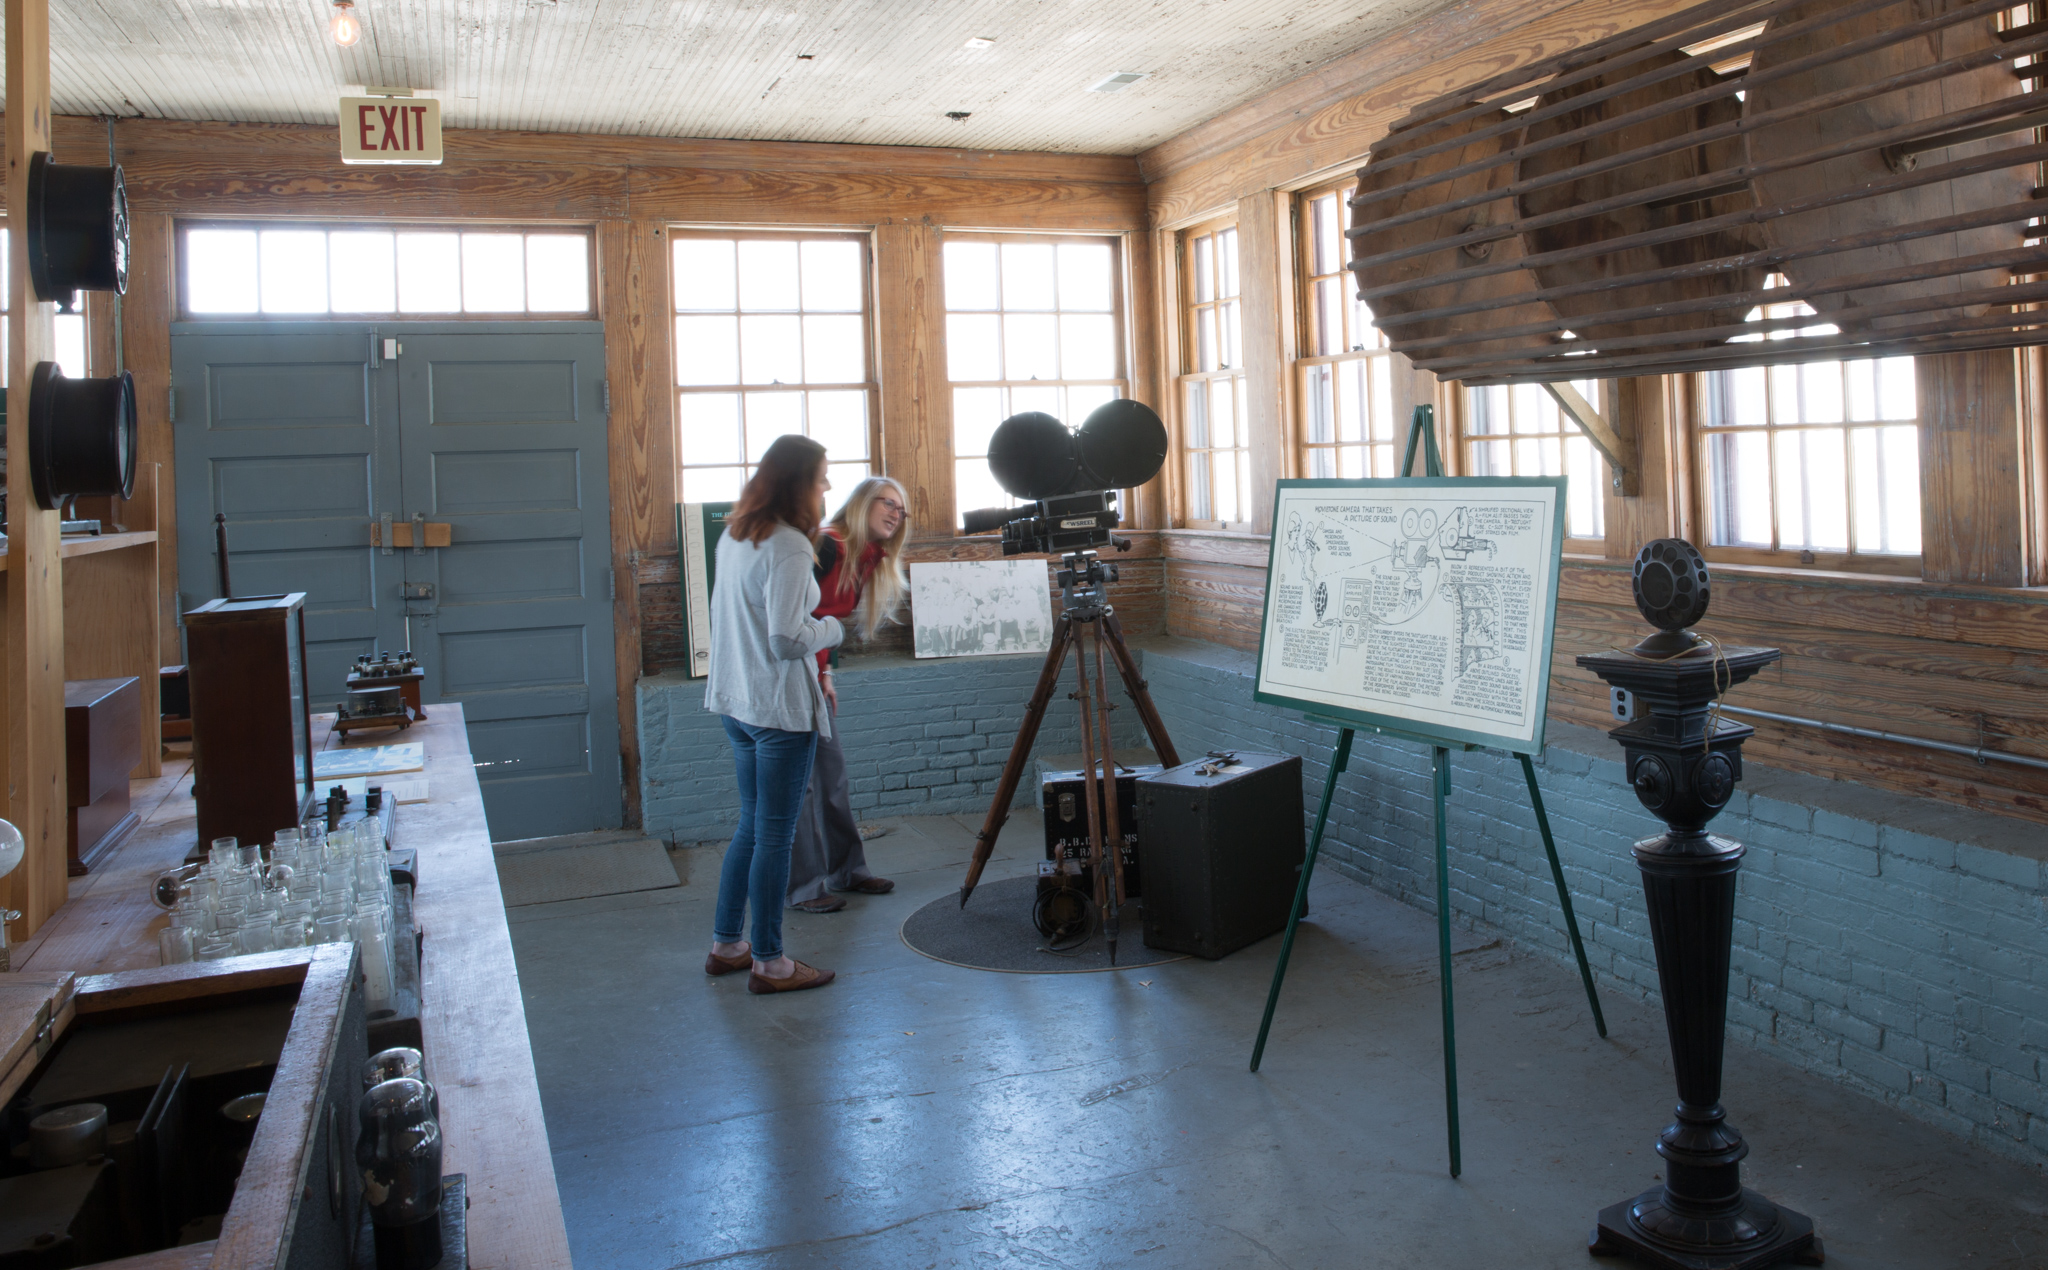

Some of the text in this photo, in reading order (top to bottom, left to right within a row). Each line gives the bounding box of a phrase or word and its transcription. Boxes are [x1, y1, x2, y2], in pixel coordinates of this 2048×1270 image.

[358, 105, 427, 151] EXIT
[1362, 506, 1375, 514] THAT
[1376, 506, 1392, 514] TAKES
[1350, 514, 1372, 522] PICTURE
